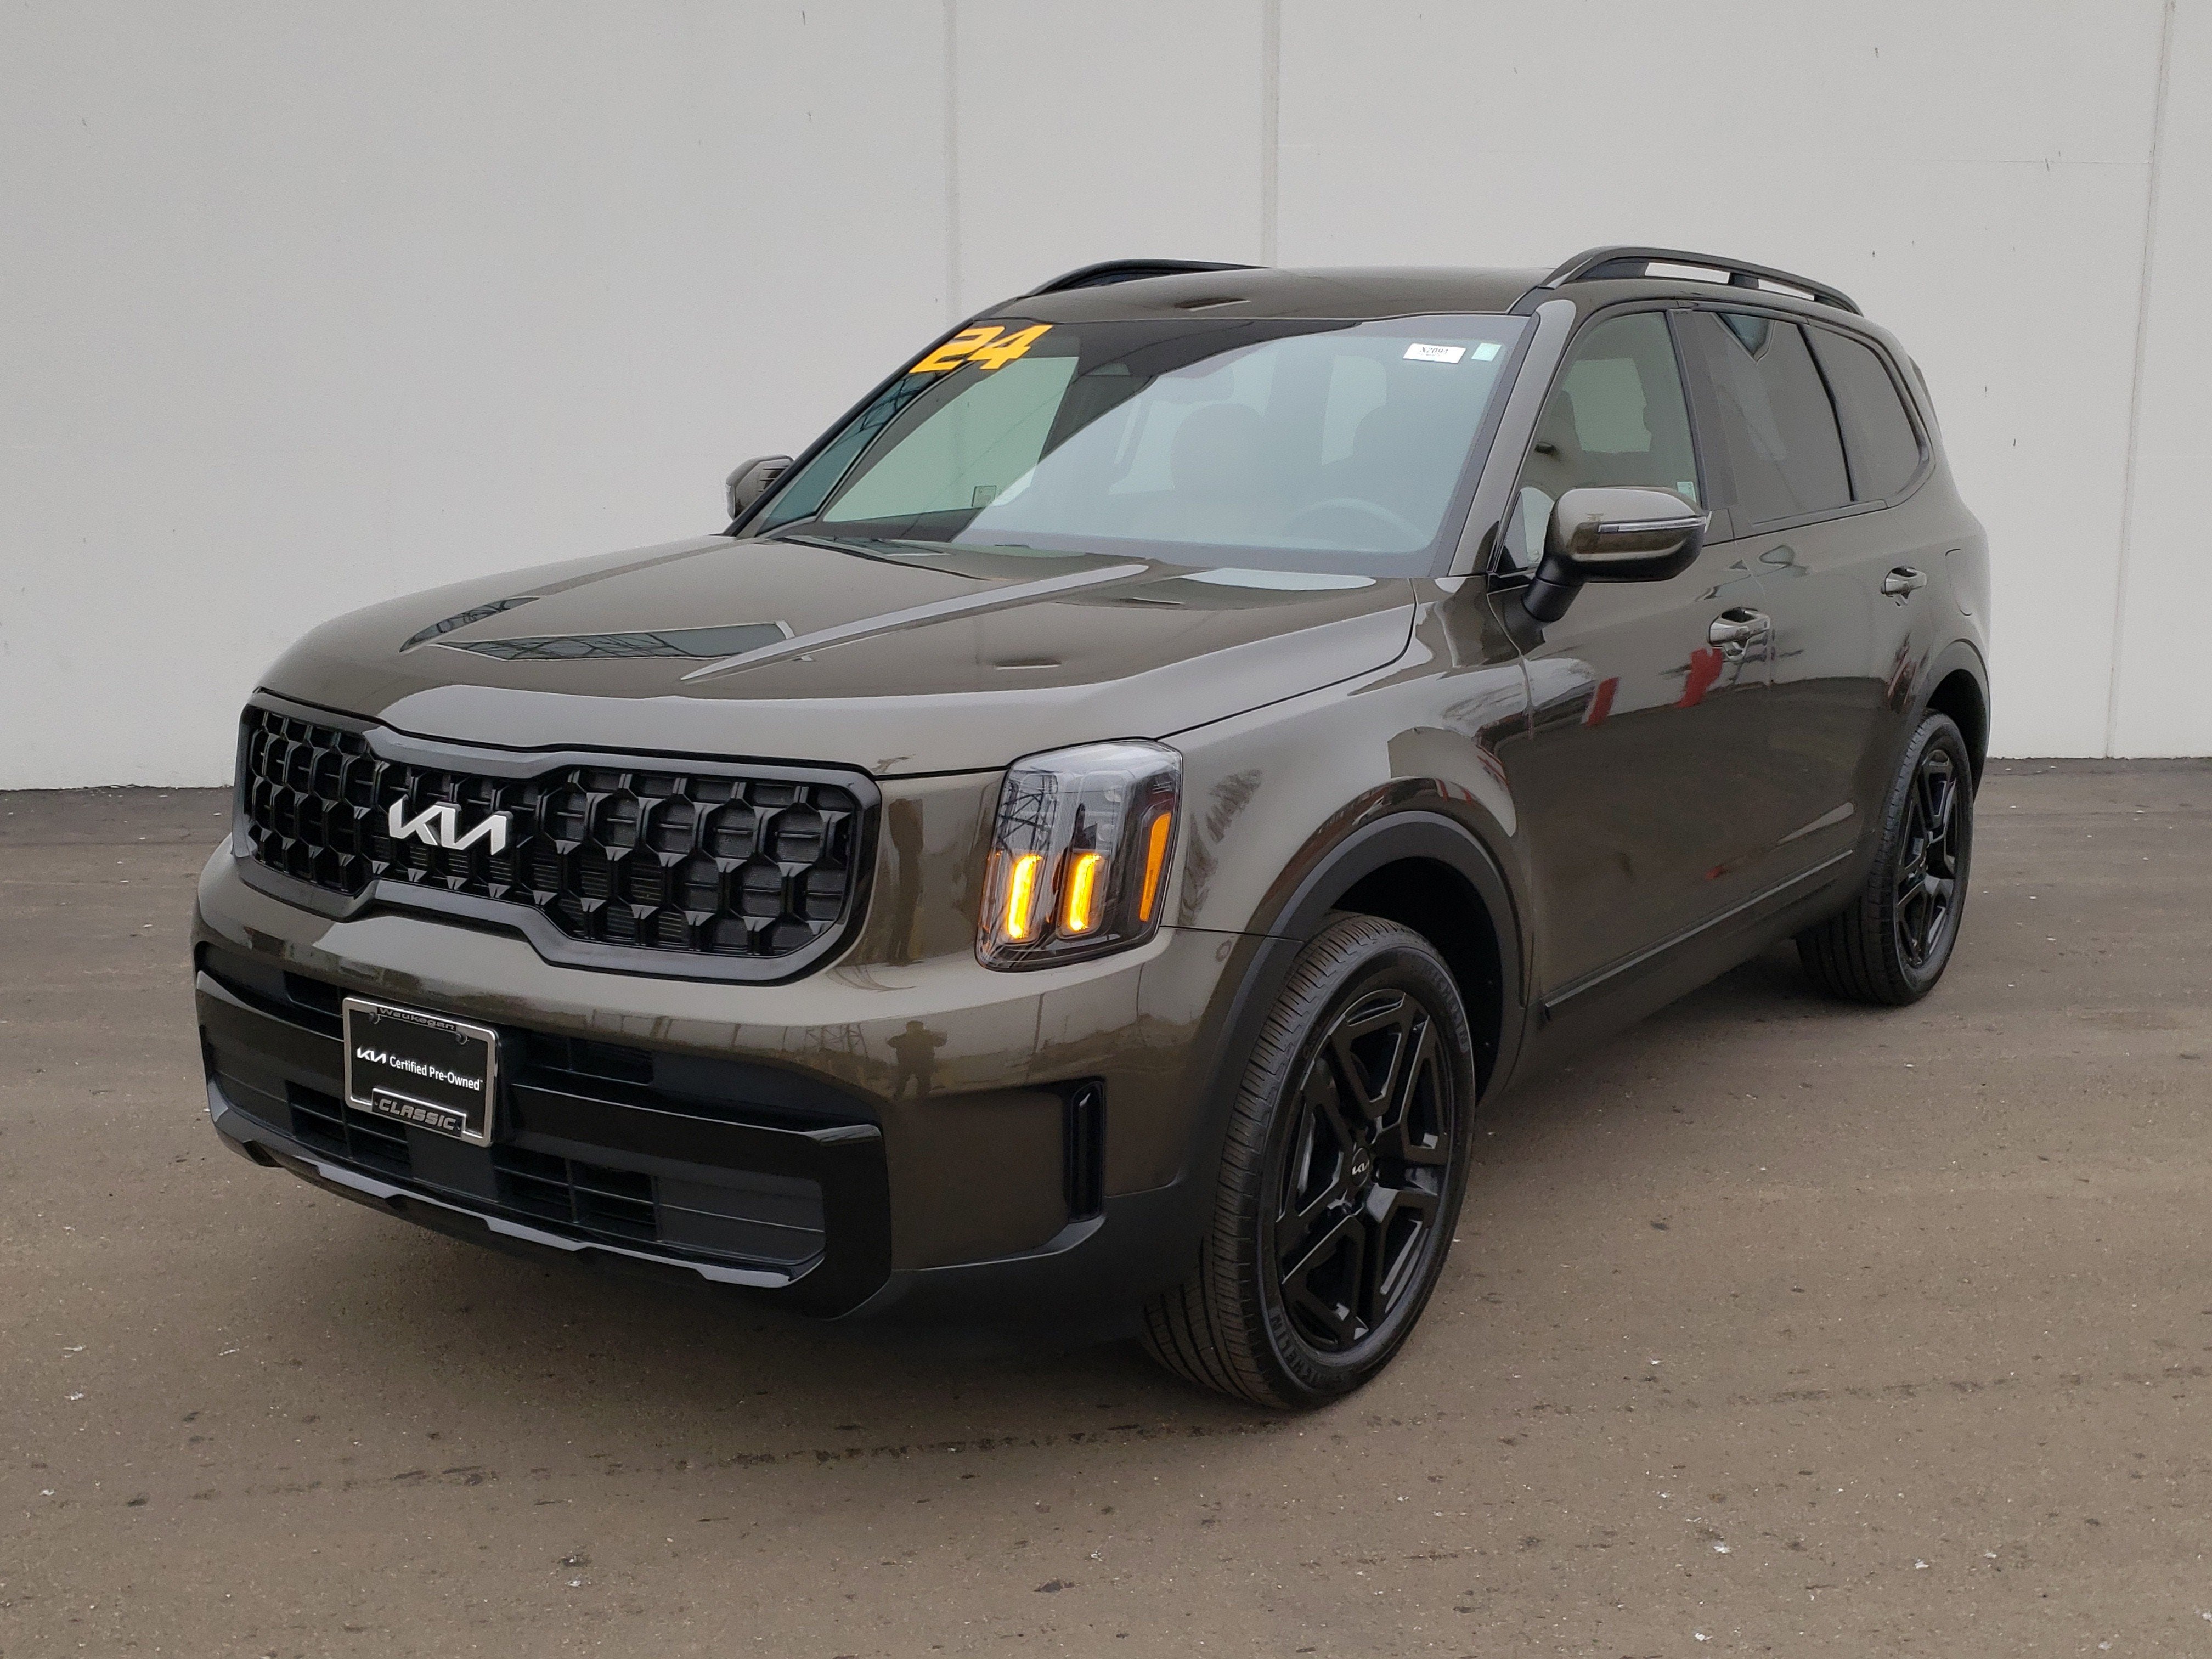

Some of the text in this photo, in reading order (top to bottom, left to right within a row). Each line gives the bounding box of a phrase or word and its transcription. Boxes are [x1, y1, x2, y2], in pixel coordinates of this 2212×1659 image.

[909, 324, 1053, 373] 24
[388, 794, 510, 855] KIA
[379, 1007, 455, 1031] Waukegan
[357, 1047, 480, 1091] KIA Certified Pre-Owned
[379, 1099, 456, 1131] CLASSIC
